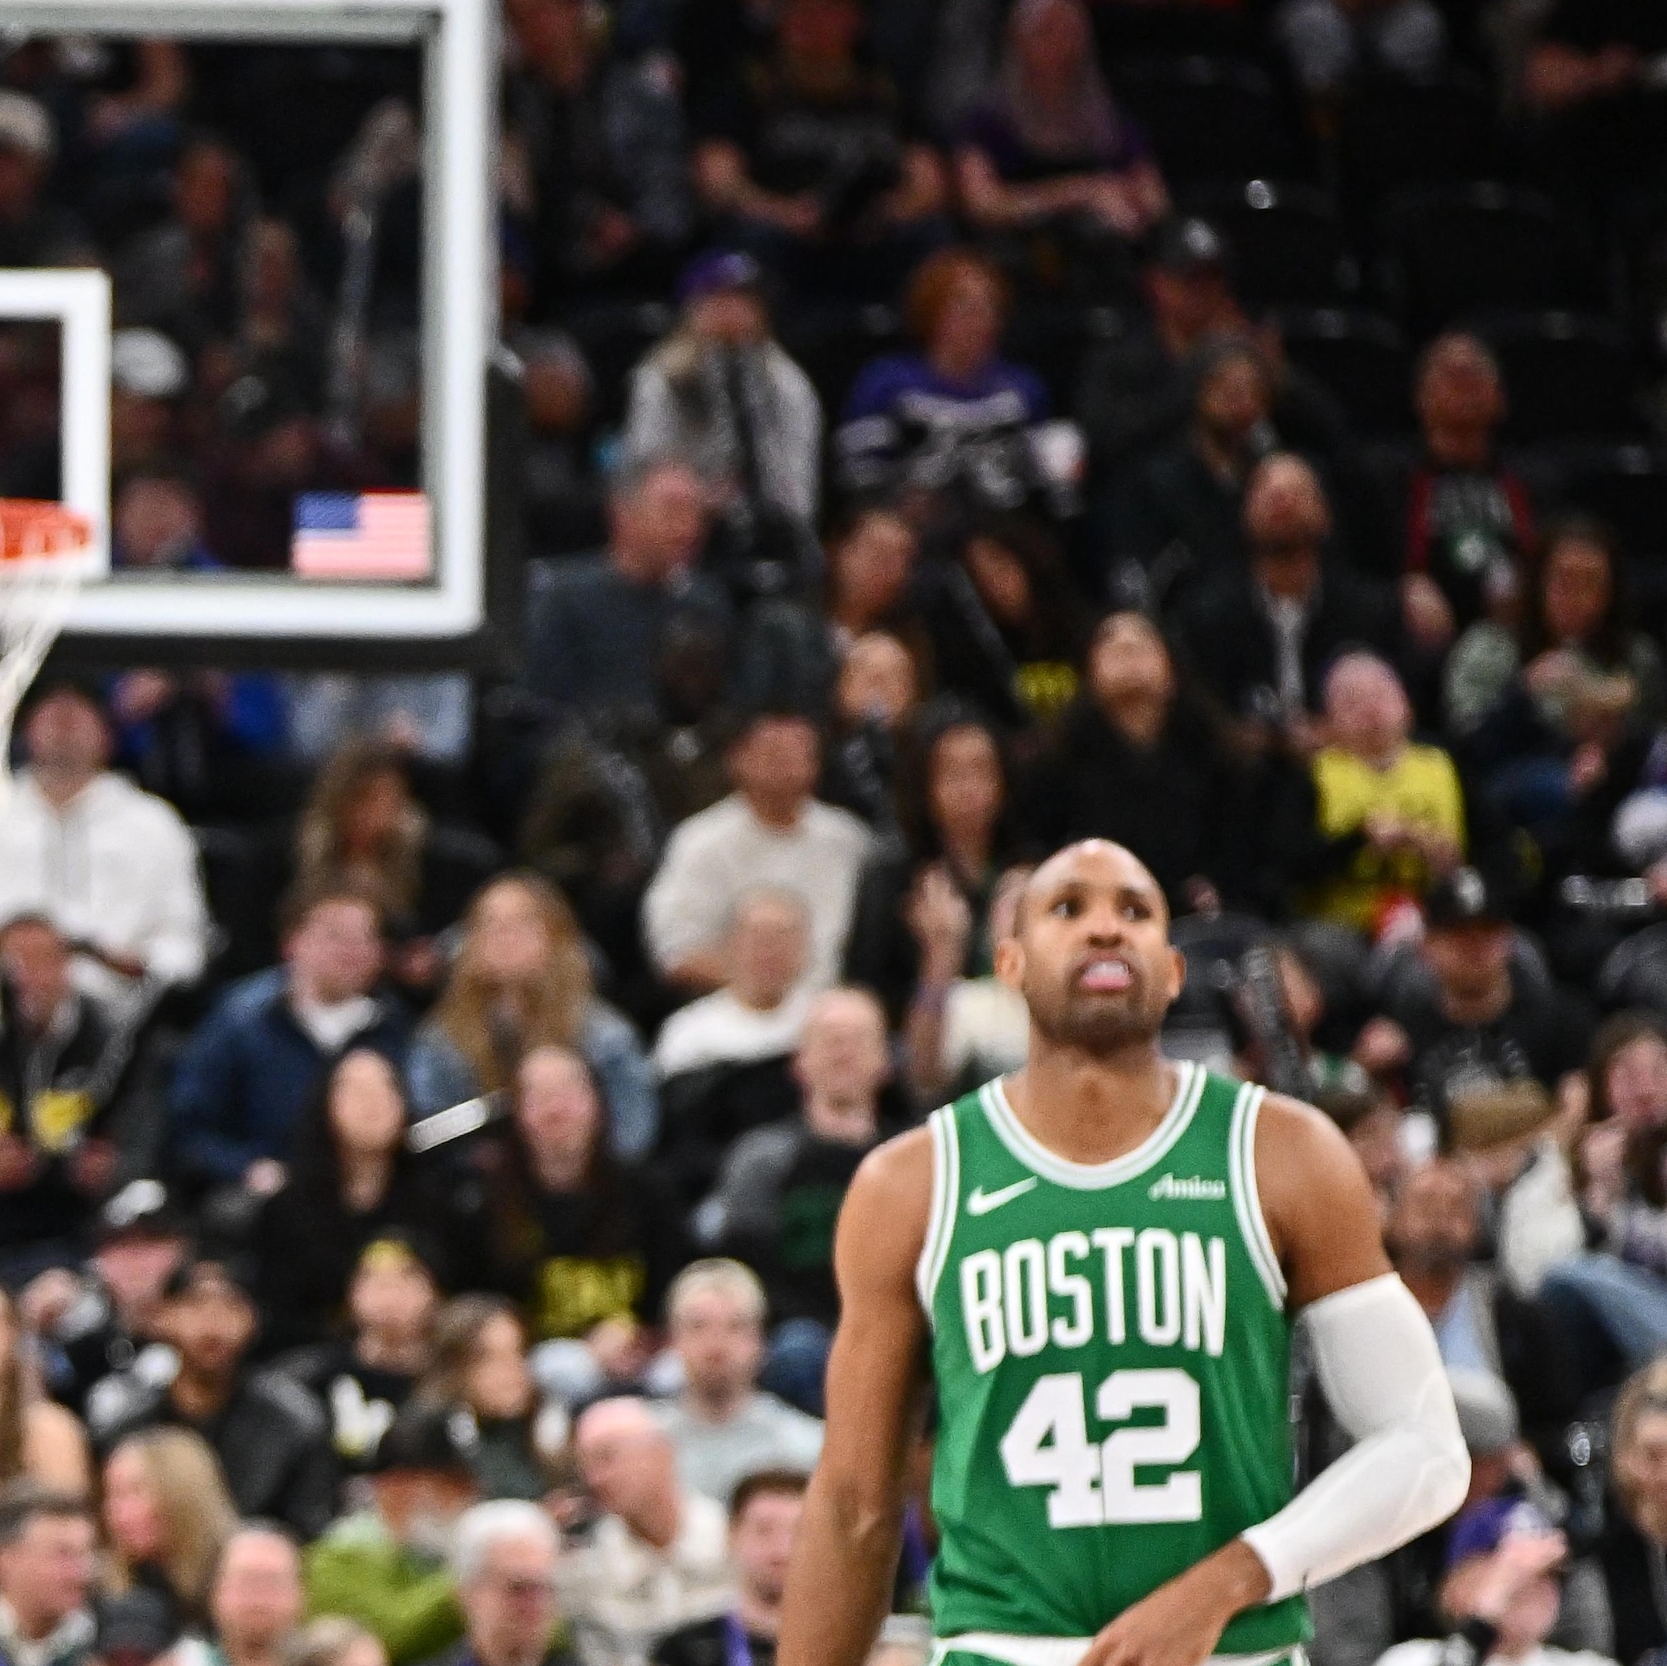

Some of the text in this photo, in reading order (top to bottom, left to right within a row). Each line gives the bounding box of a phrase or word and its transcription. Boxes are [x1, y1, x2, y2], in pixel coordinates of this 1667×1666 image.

[1147, 1171, 1227, 1202] Amica
[959, 1226, 1228, 1375] BOSTON
[999, 1367, 1204, 1530] 42
